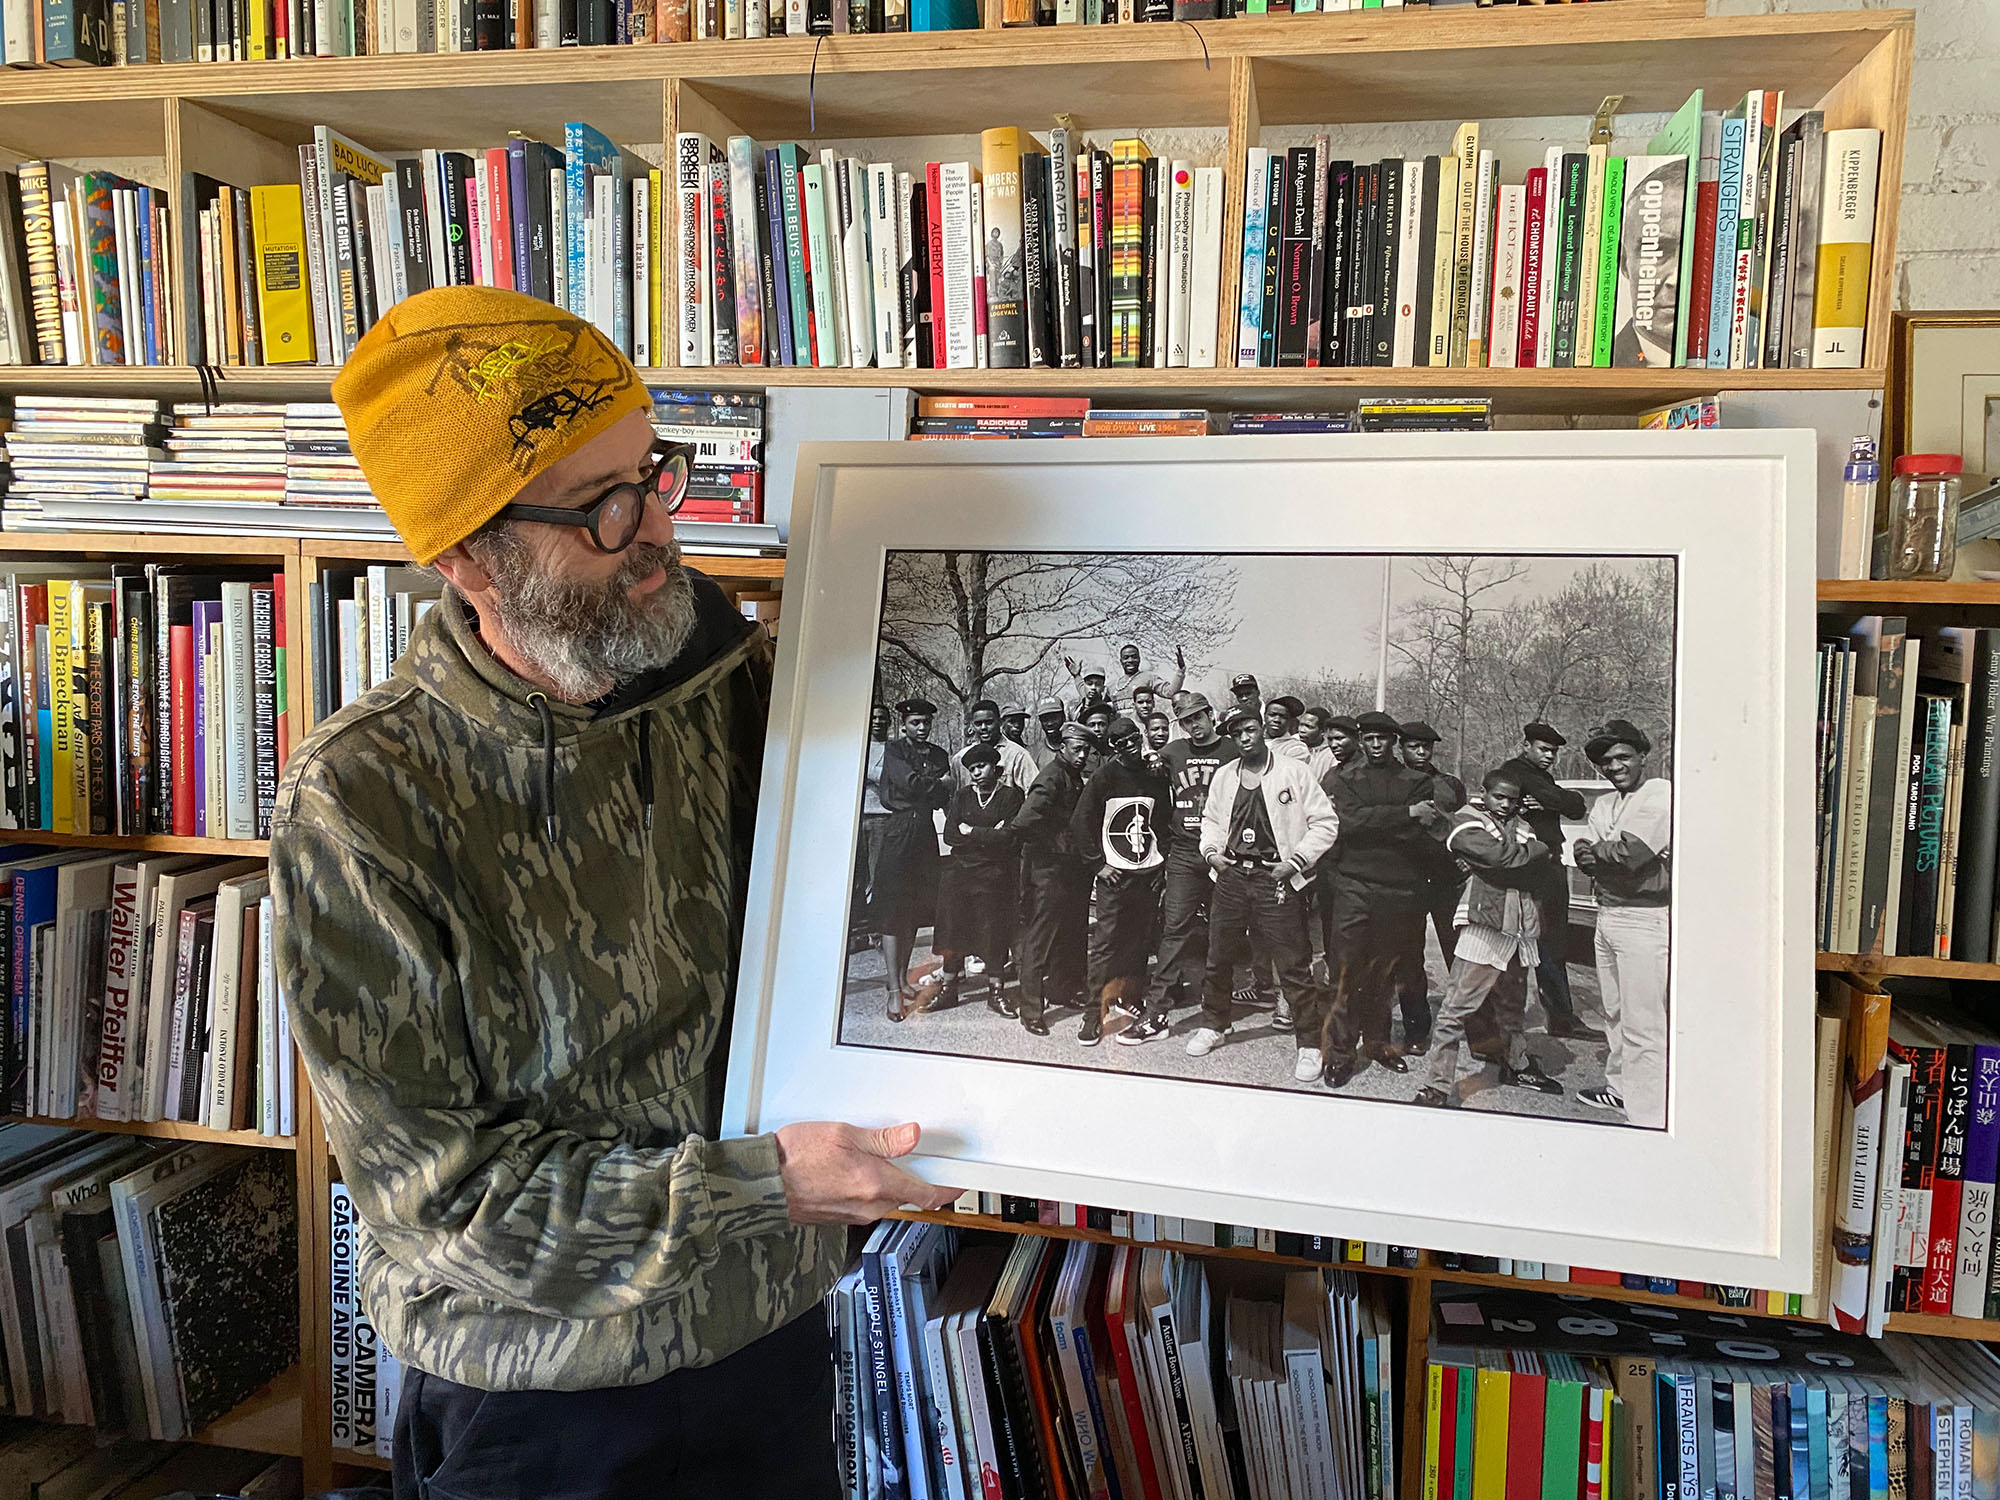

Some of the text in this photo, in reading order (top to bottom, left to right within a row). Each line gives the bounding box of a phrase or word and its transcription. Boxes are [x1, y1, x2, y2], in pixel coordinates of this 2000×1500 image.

[20, 178, 47, 190] MIKE
[334, 143, 379, 178] BAD LUCK
[681, 138, 690, 188] SCREEN
[690, 138, 699, 188] BROKEN
[1052, 143, 1066, 233] STARGAZER
[1094, 160, 1102, 189] NELSON
[1720, 126, 1741, 231] STRANGERS
[1845, 150, 1860, 220] KIPPENBERGER
[784, 162, 800, 257] JOSEPH BEUYS
[1174, 192, 1182, 219] Manuel
[1182, 192, 1190, 234] Philosophy
[1294, 153, 1307, 235] Life Against Death
[22, 191, 54, 259] TYSON
[931, 223, 942, 277] ALCHEMY
[1025, 202, 1033, 246] SCULPTING
[1030, 197, 1041, 290] ANDREY TARKOVSKY
[1457, 136, 1474, 320] GLYMPH OUT OF THE HOUSE OF BONDAGE
[1563, 163, 1580, 291] Subliminal Leonard Mlodinow
[1606, 245, 1614, 254] VU
[334, 185, 356, 335] WHITE GIRLS HILTON ALS
[393, 243, 404, 295] Francis Bacon
[763, 254, 771, 282] Afflicted
[1027, 249, 1032, 258] IN
[1181, 254, 1189, 294] Simulation
[1526, 222, 1540, 317] CHOMSKY-FOUCAULT
[1635, 180, 1664, 331] oppenheimer
[1290, 243, 1303, 325] Norman O. Brown
[1602, 303, 1609, 312] OF
[32, 287, 62, 342] TRUTH
[990, 309, 1018, 317] LOGEVALL
[1600, 313, 1608, 342] HISTORY
[700, 443, 716, 456] ALI
[253, 592, 271, 638] CATHERINE
[54, 595, 69, 751] Dirk Braeckman
[131, 644, 139, 677] BURDEN
[159, 657, 169, 700] WILLIAM
[234, 598, 246, 804] HENRI CARTIER-BRESSON PHOTOPORTRAITS
[257, 693, 272, 726] BEAUTY
[1987, 675, 1999, 710] Holzer
[90, 660, 102, 786] THE SECRET PARIS OF THE
[159, 712, 169, 768] BURROUGHS
[1987, 715, 1997, 735] War
[258, 761, 274, 777] THE
[1981, 734, 1995, 778] Paintings
[257, 779, 274, 795] EYE
[1908, 755, 1920, 830] POOL TARO HIRANO
[1848, 769, 1865, 901] INTERIOR AMERICA
[1916, 795, 1943, 873] PICTURES
[14, 877, 25, 995] DENNIS OPPENHEIM
[156, 900, 165, 937] PALERMO
[100, 883, 137, 1092] Walter Pfeiffer
[217, 1029, 228, 1106] PIER PAOLO PASOLINI
[1940, 1065, 1969, 1177] にっぽん劇場
[67, 1183, 99, 1205] Who
[1852, 1125, 1871, 1210] PHILIP TAAFFE
[1929, 1237, 1952, 1305] 森山大道
[333, 1194, 349, 1439] GASOLINE AND MAGIC
[868, 1287, 886, 1395] RUDOLF STINGEL
[1055, 1321, 1067, 1350] foam
[354, 1324, 376, 1447] CAMERA
[1162, 1324, 1195, 1464] Atelier Bow-Wow A Primer
[1628, 1365, 1647, 1376] 25
[843, 1351, 857, 1491] PETERSOTOSPROXY
[1680, 1388, 1696, 1496] FRANCIS ALŸS
[1958, 1419, 1972, 1473] ROMAN
[1938, 1418, 1951, 1491] STEPHEN
